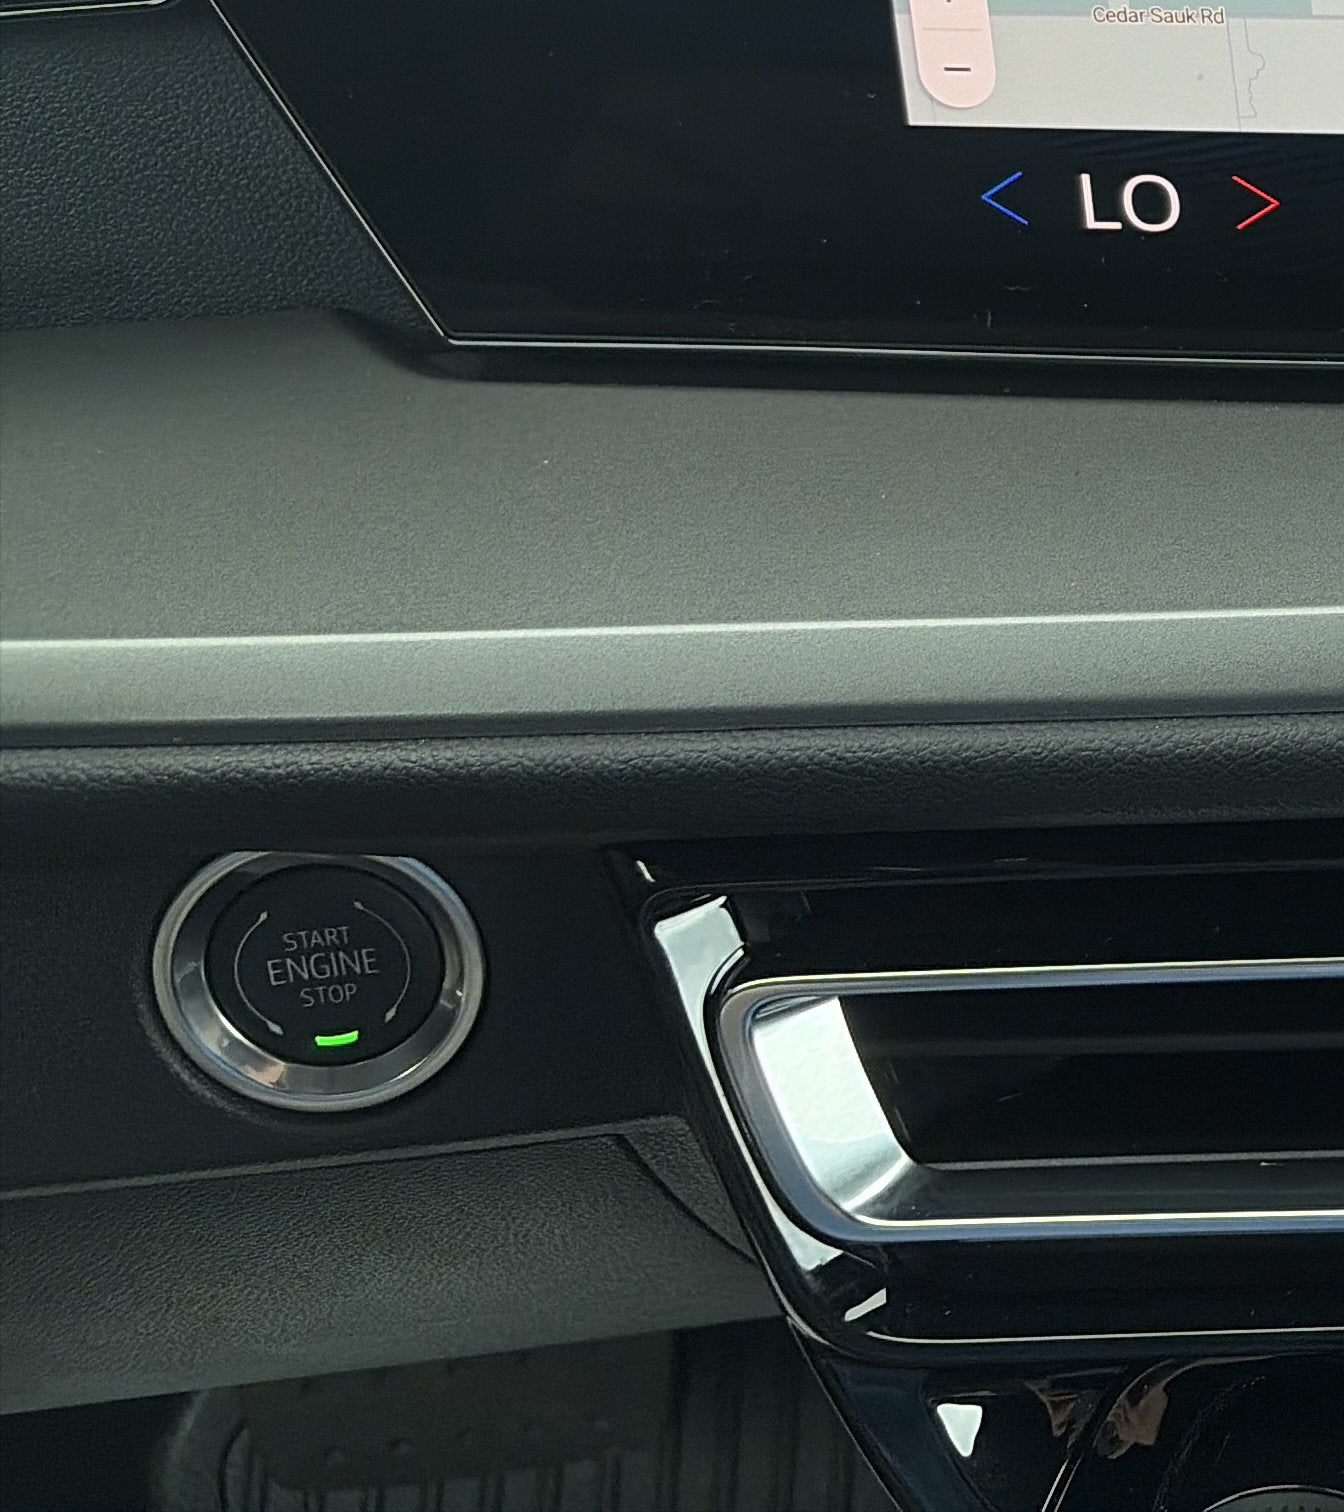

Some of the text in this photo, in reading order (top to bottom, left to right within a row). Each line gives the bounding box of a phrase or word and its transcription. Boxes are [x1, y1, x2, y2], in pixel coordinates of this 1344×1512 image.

[1092, 6, 1224, 25] Cedar Sauk Rd
[1080, 173, 1181, 232] LO
[283, 927, 350, 951] START
[266, 948, 380, 986] ENGINE
[300, 984, 358, 1008] STOP
